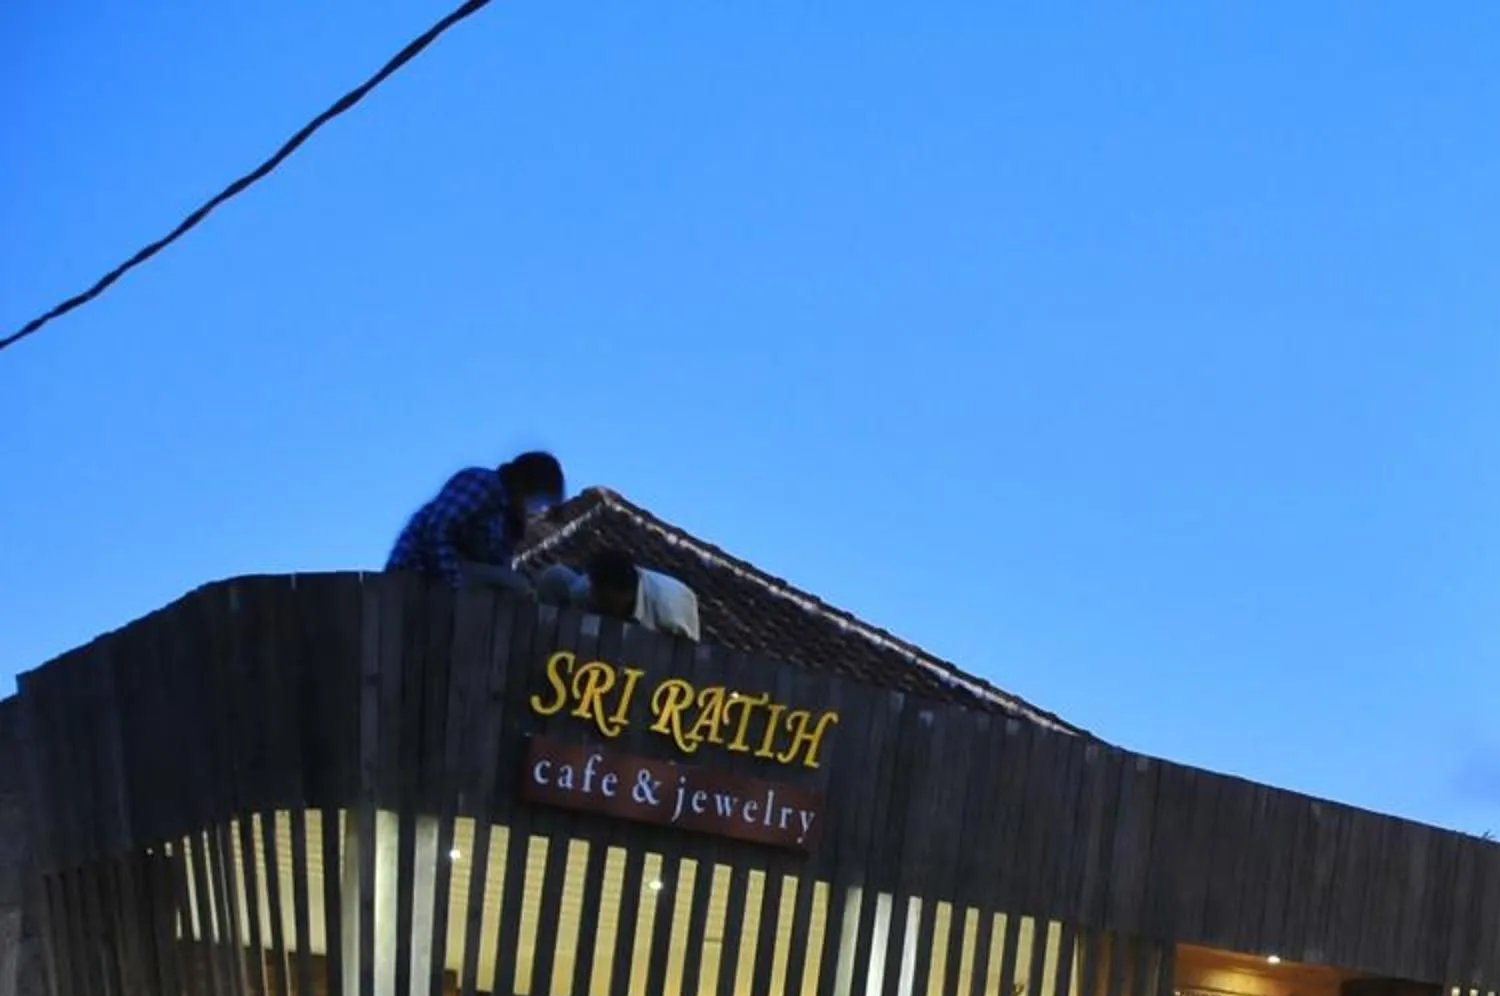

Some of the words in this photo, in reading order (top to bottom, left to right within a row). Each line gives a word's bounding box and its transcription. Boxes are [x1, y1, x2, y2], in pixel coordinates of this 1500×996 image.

[530, 650, 645, 738] SRI
[650, 678, 838, 768] RATIH
[532, 754, 619, 797] cafe
[631, 767, 662, 806] &
[670, 775, 816, 844] jewelry
